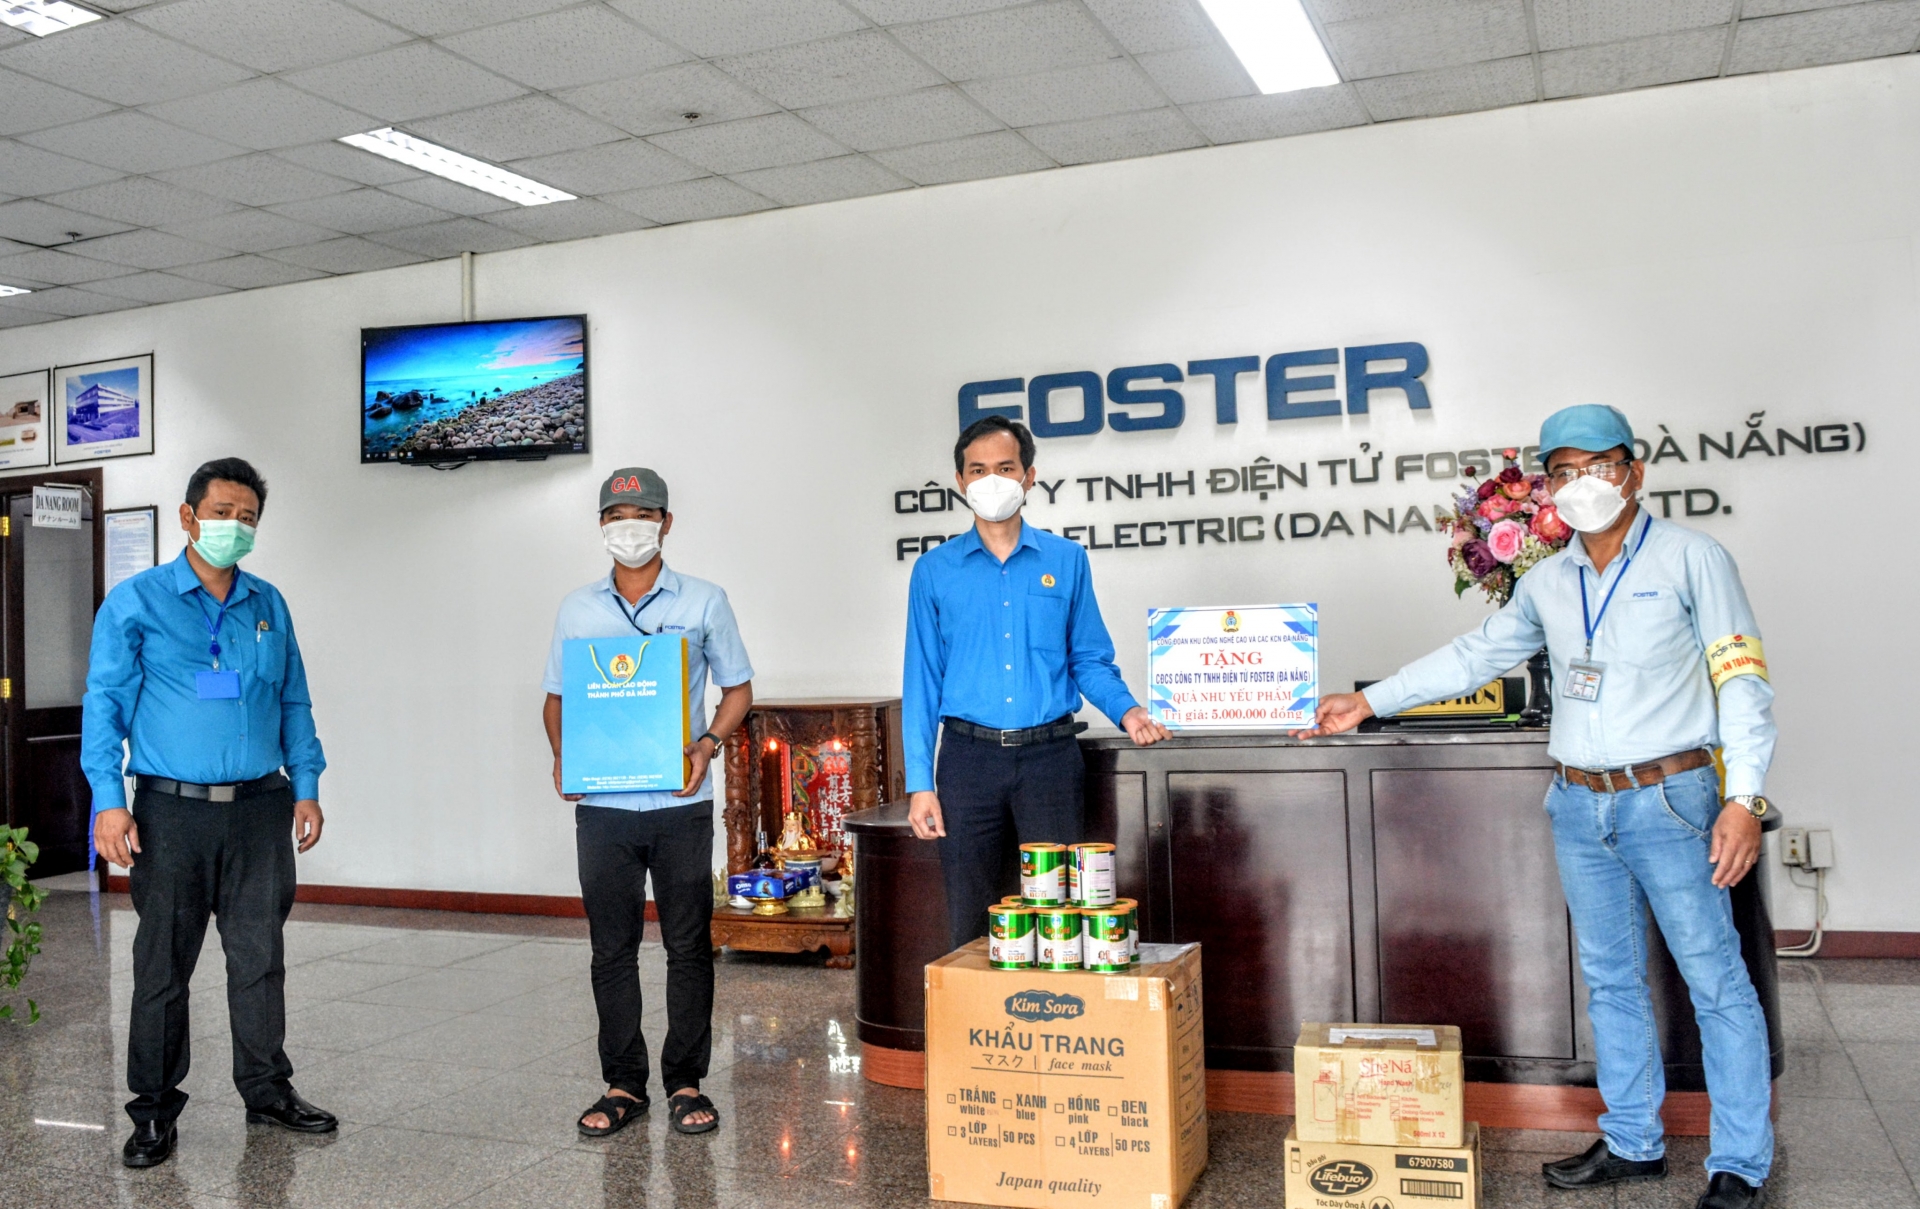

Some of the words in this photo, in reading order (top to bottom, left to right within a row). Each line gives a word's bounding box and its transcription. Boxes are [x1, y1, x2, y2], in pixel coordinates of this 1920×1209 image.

[957, 341, 1432, 439] FOSTER
[894, 480, 972, 514] CÔN
[1076, 470, 1196, 502] TNHH
[1206, 456, 1308, 501] ĐIỆN
[1318, 442, 1384, 486] TỬ
[1395, 446, 1546, 482] FOSTE
[1698, 410, 1867, 462] NẴNG)
[610, 475, 642, 494] GA
[36, 494, 44, 510] DA
[45, 495, 61, 511] NANG
[62, 496, 79, 512] ROOM
[1063, 515, 1265, 551] ELECTRIC
[1274, 510, 1355, 541] (DA
[1156, 636, 1172, 646] CÔNG
[1189, 637, 1202, 645] KHU
[1202, 636, 1218, 645] CÔNG
[1236, 635, 1248, 644] CAO
[1270, 635, 1282, 643] KCN
[1711, 642, 1748, 660] FOSTER
[1199, 649, 1263, 669] TẶNG
[1155, 673, 1174, 685] CĐCS
[1174, 671, 1193, 684] CÔNG
[1193, 673, 1202, 684] TY
[1203, 673, 1221, 684] TNHH
[1222, 669, 1238, 685] ĐIỆN
[1249, 671, 1275, 683] FOSTER
[587, 682, 601, 690] LIÊN
[587, 691, 610, 699] THÀNH
[1200, 692, 1227, 703] NHU
[1229, 688, 1254, 702] YẾU
[1162, 709, 1182, 722] Trị
[1185, 709, 1209, 721] giá:
[1211, 708, 1267, 720] 5.000.000
[1269, 705, 1303, 720] đồng
[1011, 997, 1041, 1013] Kim
[1043, 999, 1079, 1015] Sora
[969, 1021, 1033, 1051] KHẨU
[1040, 1034, 1125, 1058] TRANG
[982, 1053, 1023, 1069] マスク
[1047, 1057, 1075, 1072] face
[1081, 1061, 1112, 1072] mask
[959, 1085, 997, 1105] TRẮNG
[1016, 1093, 1047, 1109] XANH
[959, 1104, 986, 1116] white
[1016, 1108, 1036, 1121] blue
[1121, 1100, 1148, 1115] ĐEN
[1068, 1112, 1089, 1125] pink
[1121, 1115, 1149, 1128] black
[960, 1126, 966, 1139] 3
[968, 1120, 987, 1135] LỚP
[968, 1136, 998, 1149] LAYERS
[1003, 1131, 1015, 1143] 50
[1018, 1132, 1036, 1146] PCS
[1069, 1136, 1076, 1149] 4
[1078, 1129, 1099, 1144] LỚP
[1078, 1146, 1110, 1157] LAYERS
[1115, 1138, 1128, 1151] 50
[1131, 1140, 1151, 1153] PCS
[1408, 1157, 1455, 1169] 67907580
[995, 1171, 1043, 1191] Japan
[1048, 1178, 1102, 1198] quality
[1314, 1171, 1369, 1186] Lifebuoy
[1315, 1198, 1328, 1207] Tóc
[1329, 1199, 1344, 1209] Dày
